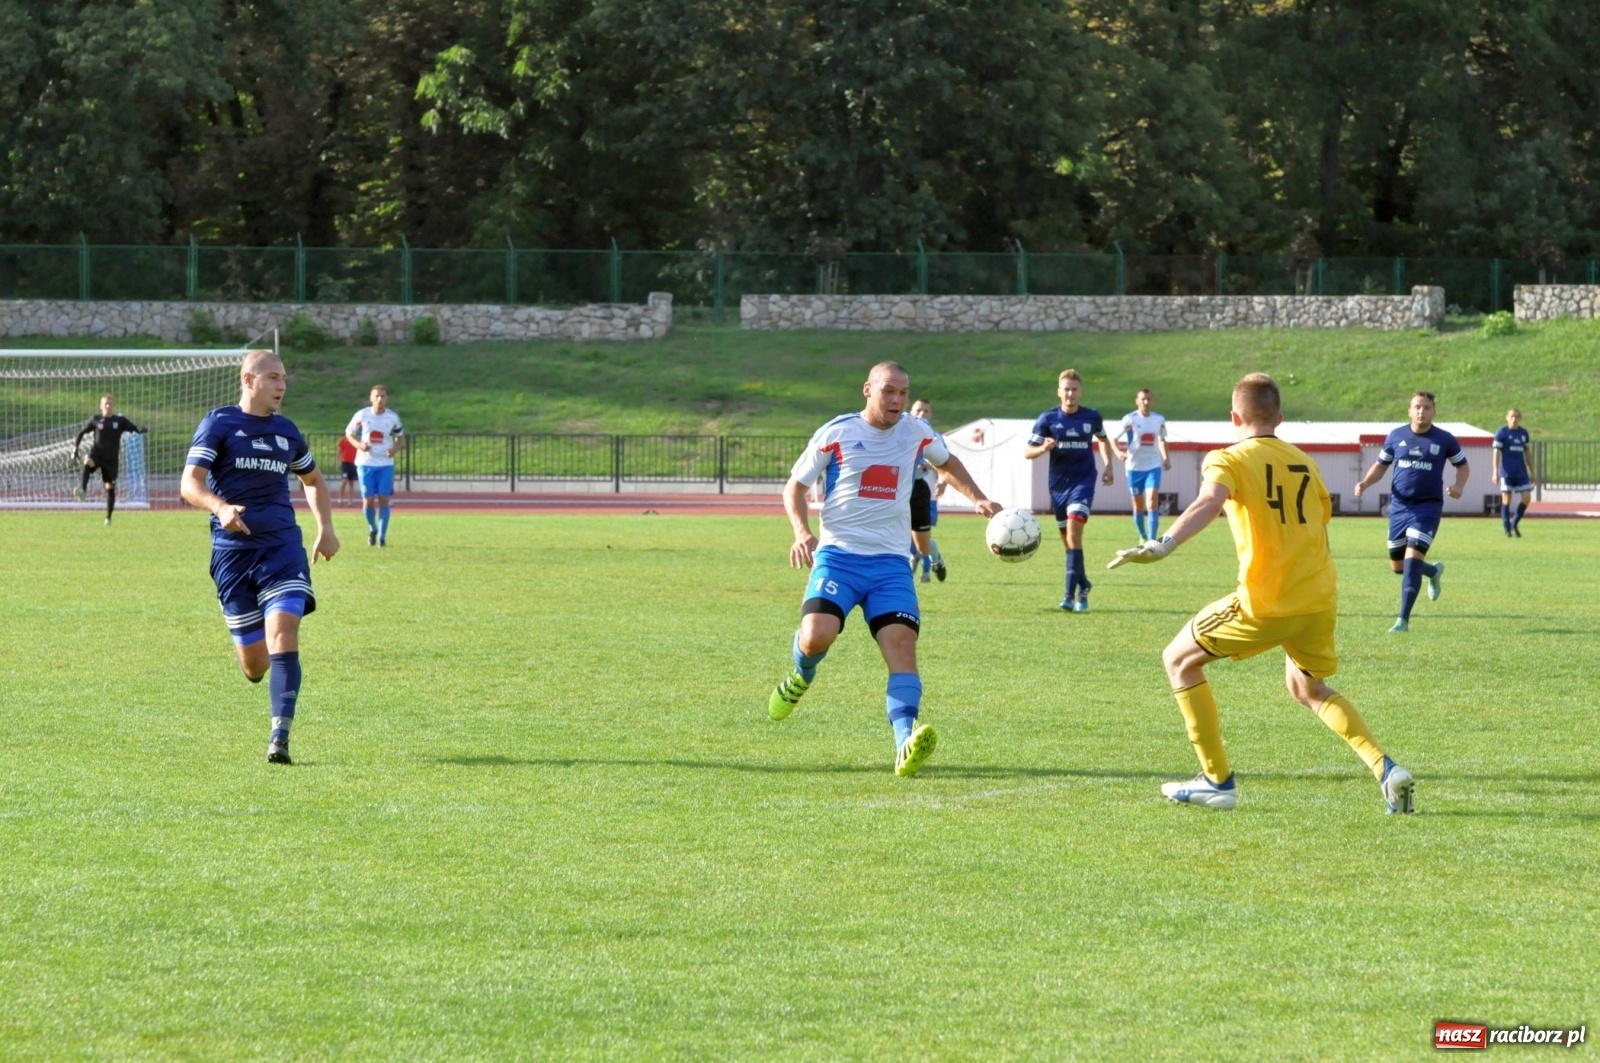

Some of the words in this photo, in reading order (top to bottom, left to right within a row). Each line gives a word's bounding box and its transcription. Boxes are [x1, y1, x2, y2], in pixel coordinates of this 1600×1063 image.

[235, 457, 288, 474] MAN-TRANS
[1397, 459, 1433, 471] MAN-TRANS
[1265, 463, 1311, 524] 47
[813, 577, 839, 596] 15
